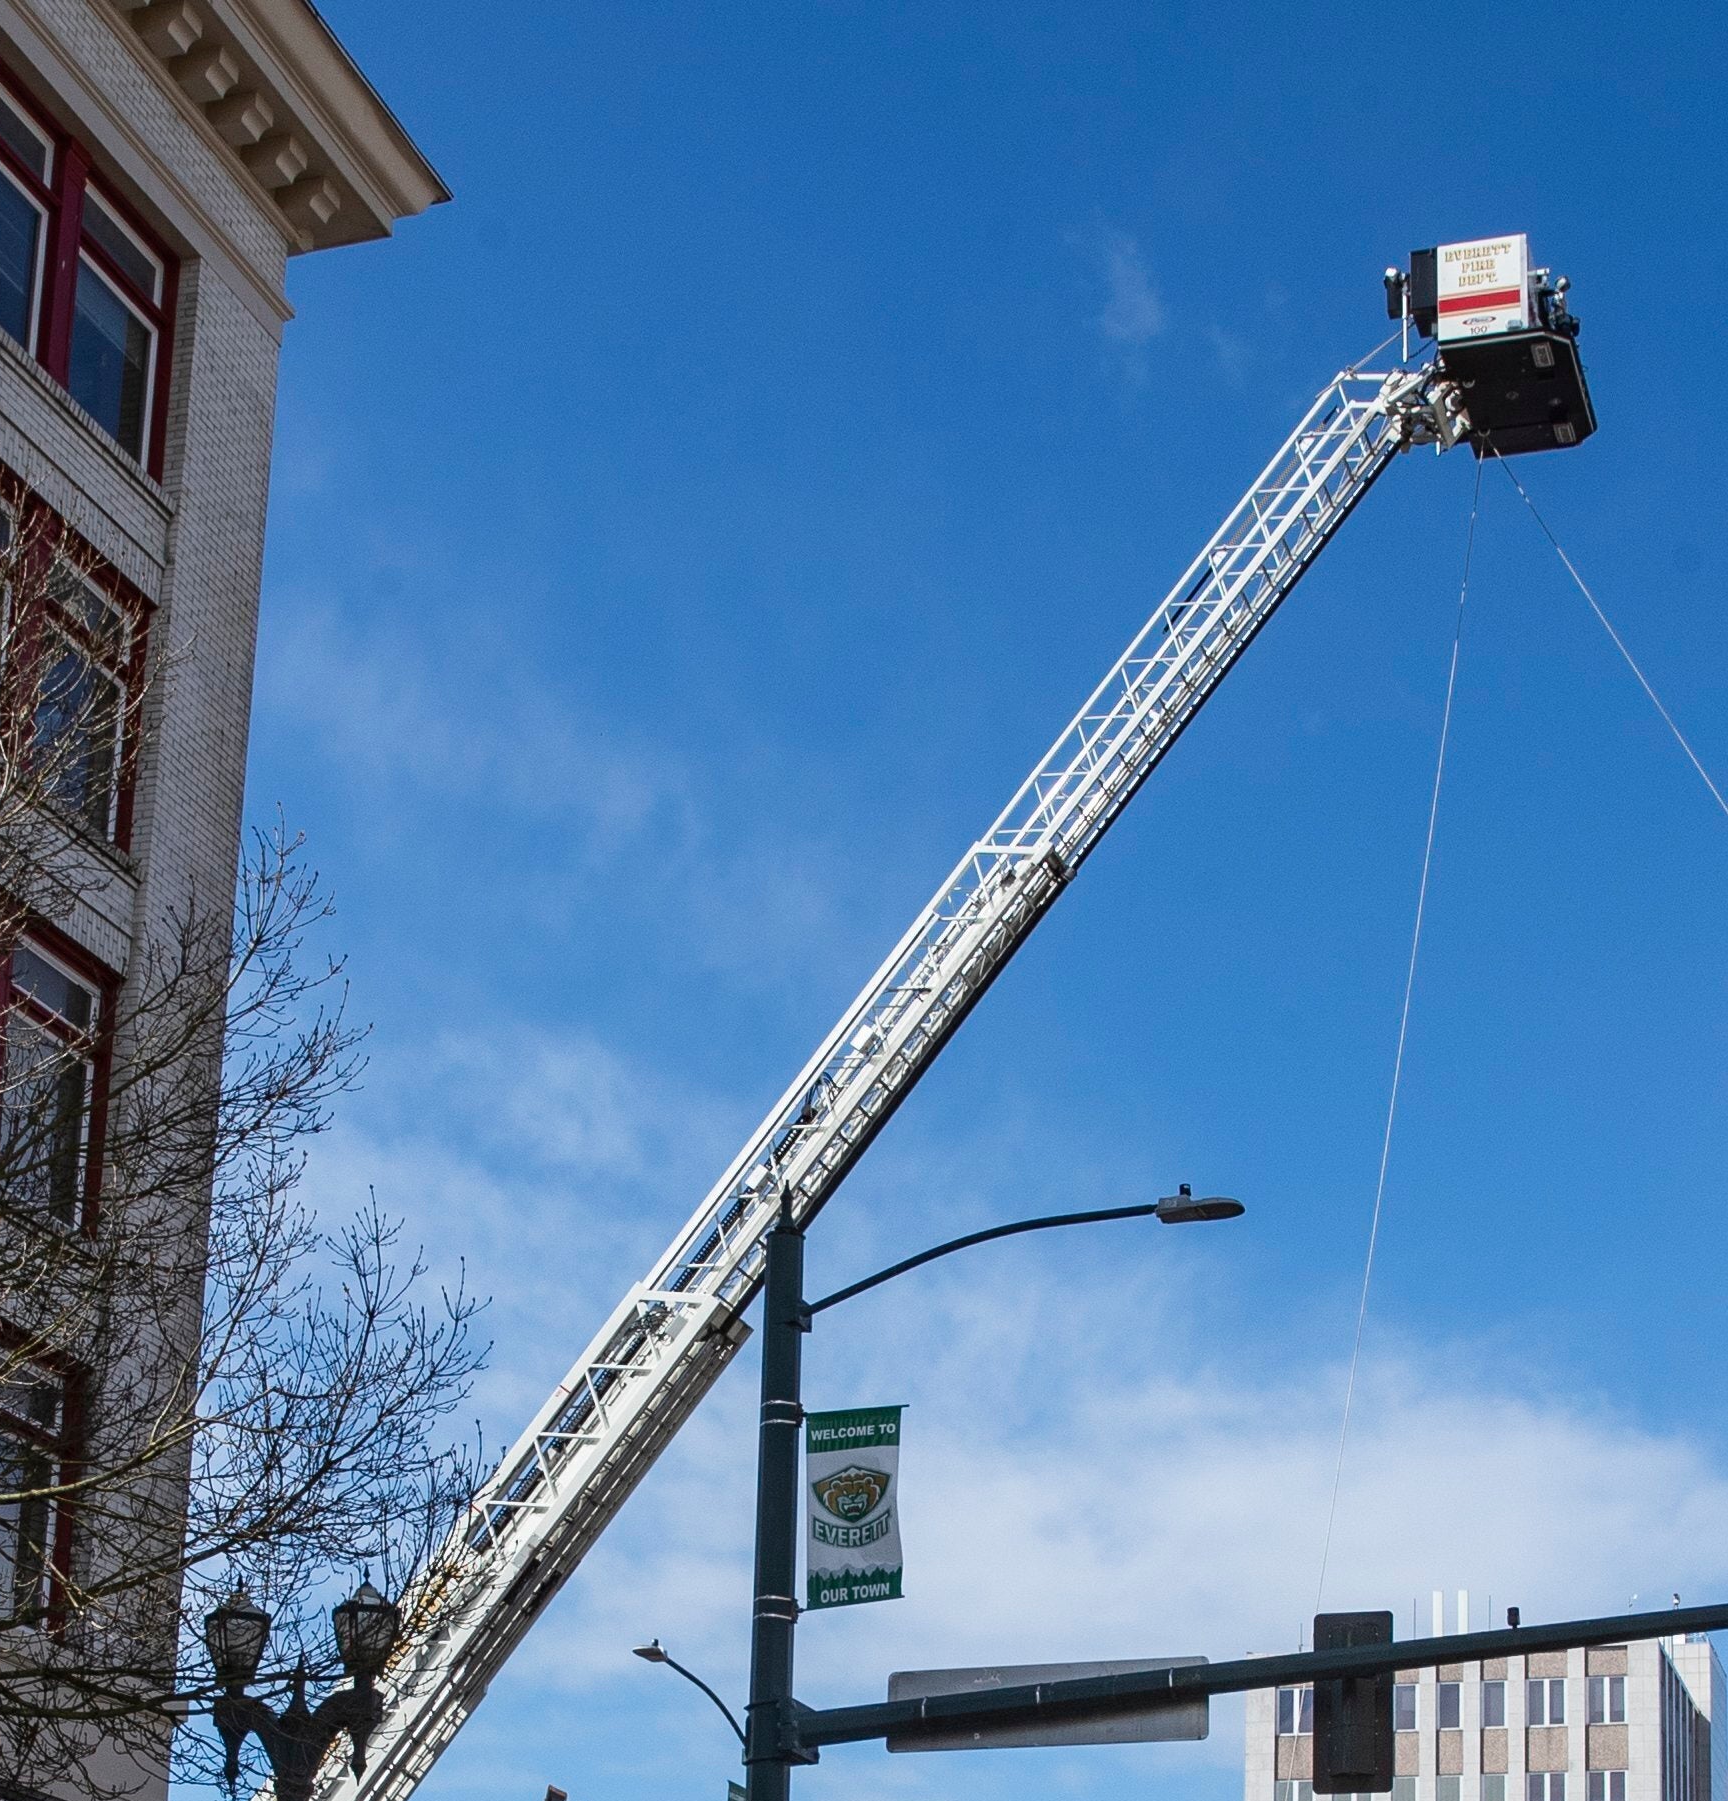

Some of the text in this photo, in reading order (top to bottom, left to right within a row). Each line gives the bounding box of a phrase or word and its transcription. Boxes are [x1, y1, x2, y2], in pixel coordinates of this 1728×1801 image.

[1445, 243, 1511, 262] EVERETT
[1462, 260, 1496, 273] FIRE
[811, 1423, 896, 1441] WELCOME TO
[814, 1513, 890, 1547] EVERETT
[820, 1583, 890, 1603] OUR TOWN
